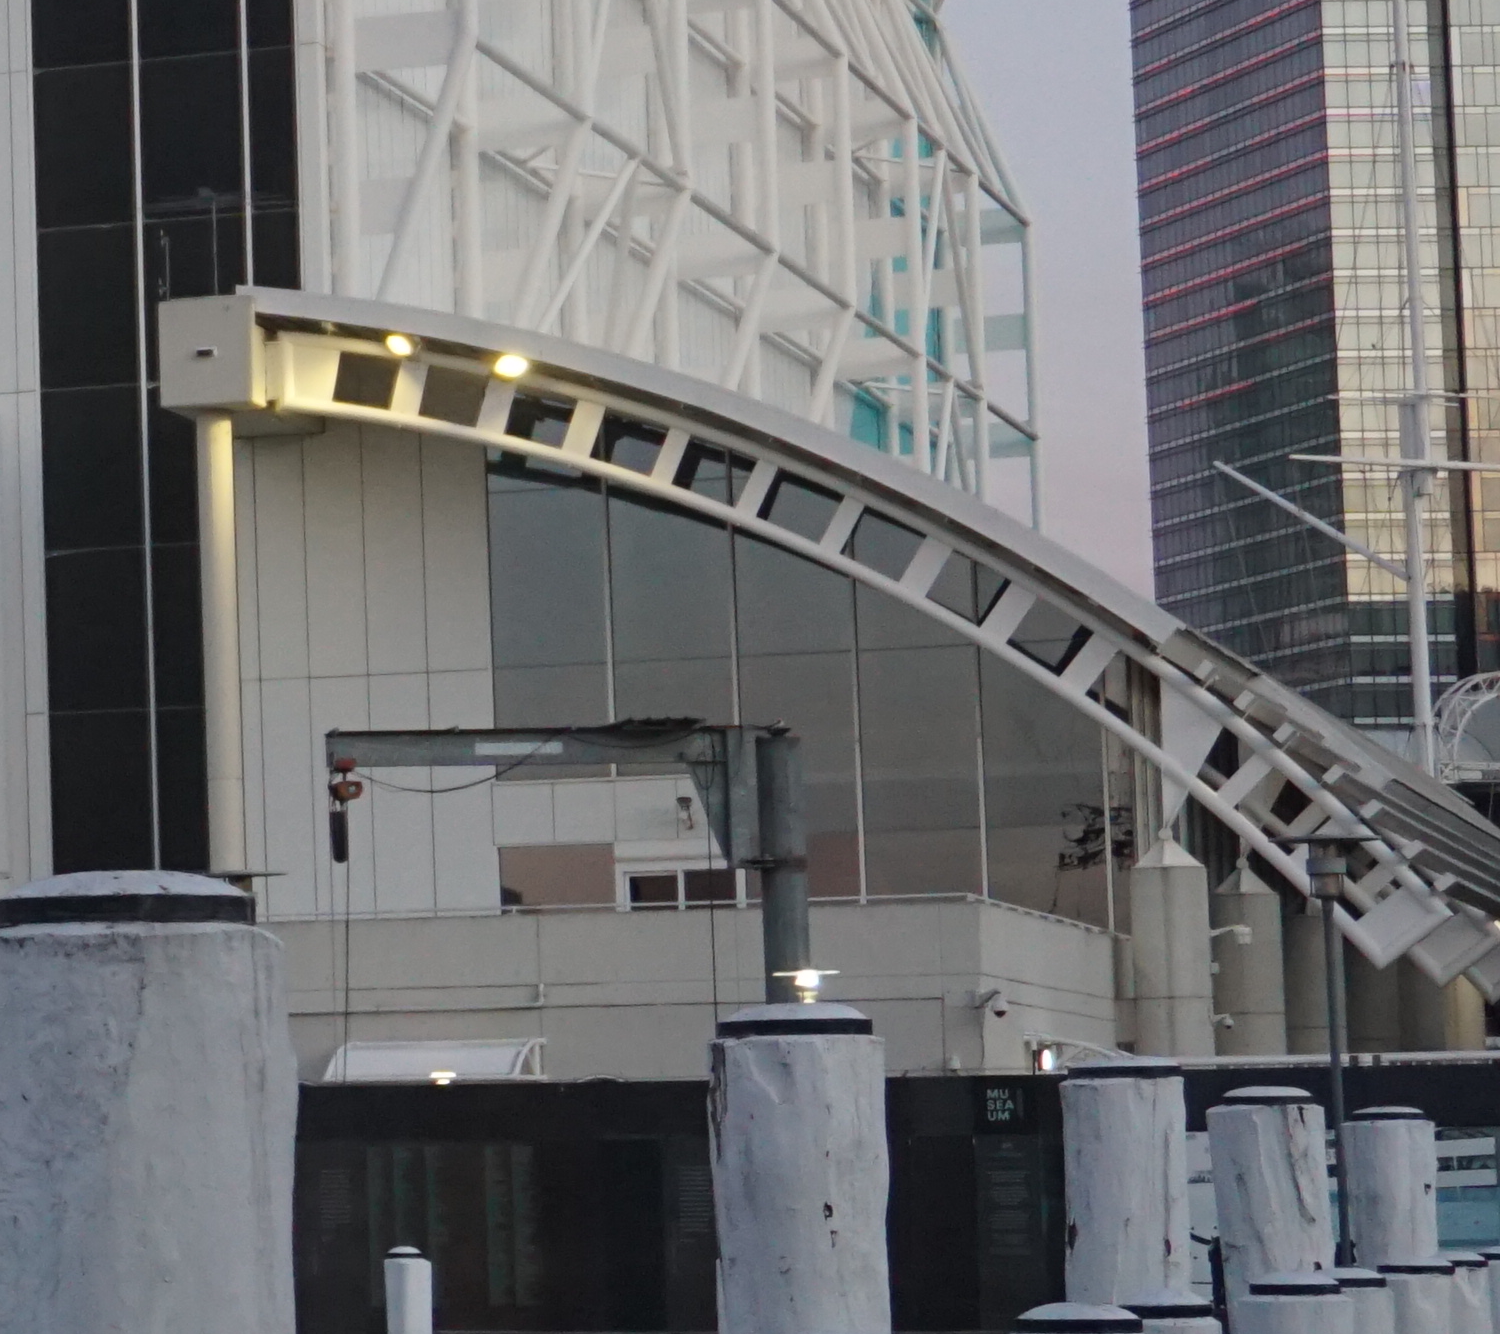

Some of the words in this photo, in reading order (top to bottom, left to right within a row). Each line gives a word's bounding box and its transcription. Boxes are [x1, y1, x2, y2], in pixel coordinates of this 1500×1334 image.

[986, 1088, 1009, 1099] MU
[986, 1099, 1015, 1110] SEA
[987, 1110, 1010, 1121] UM
